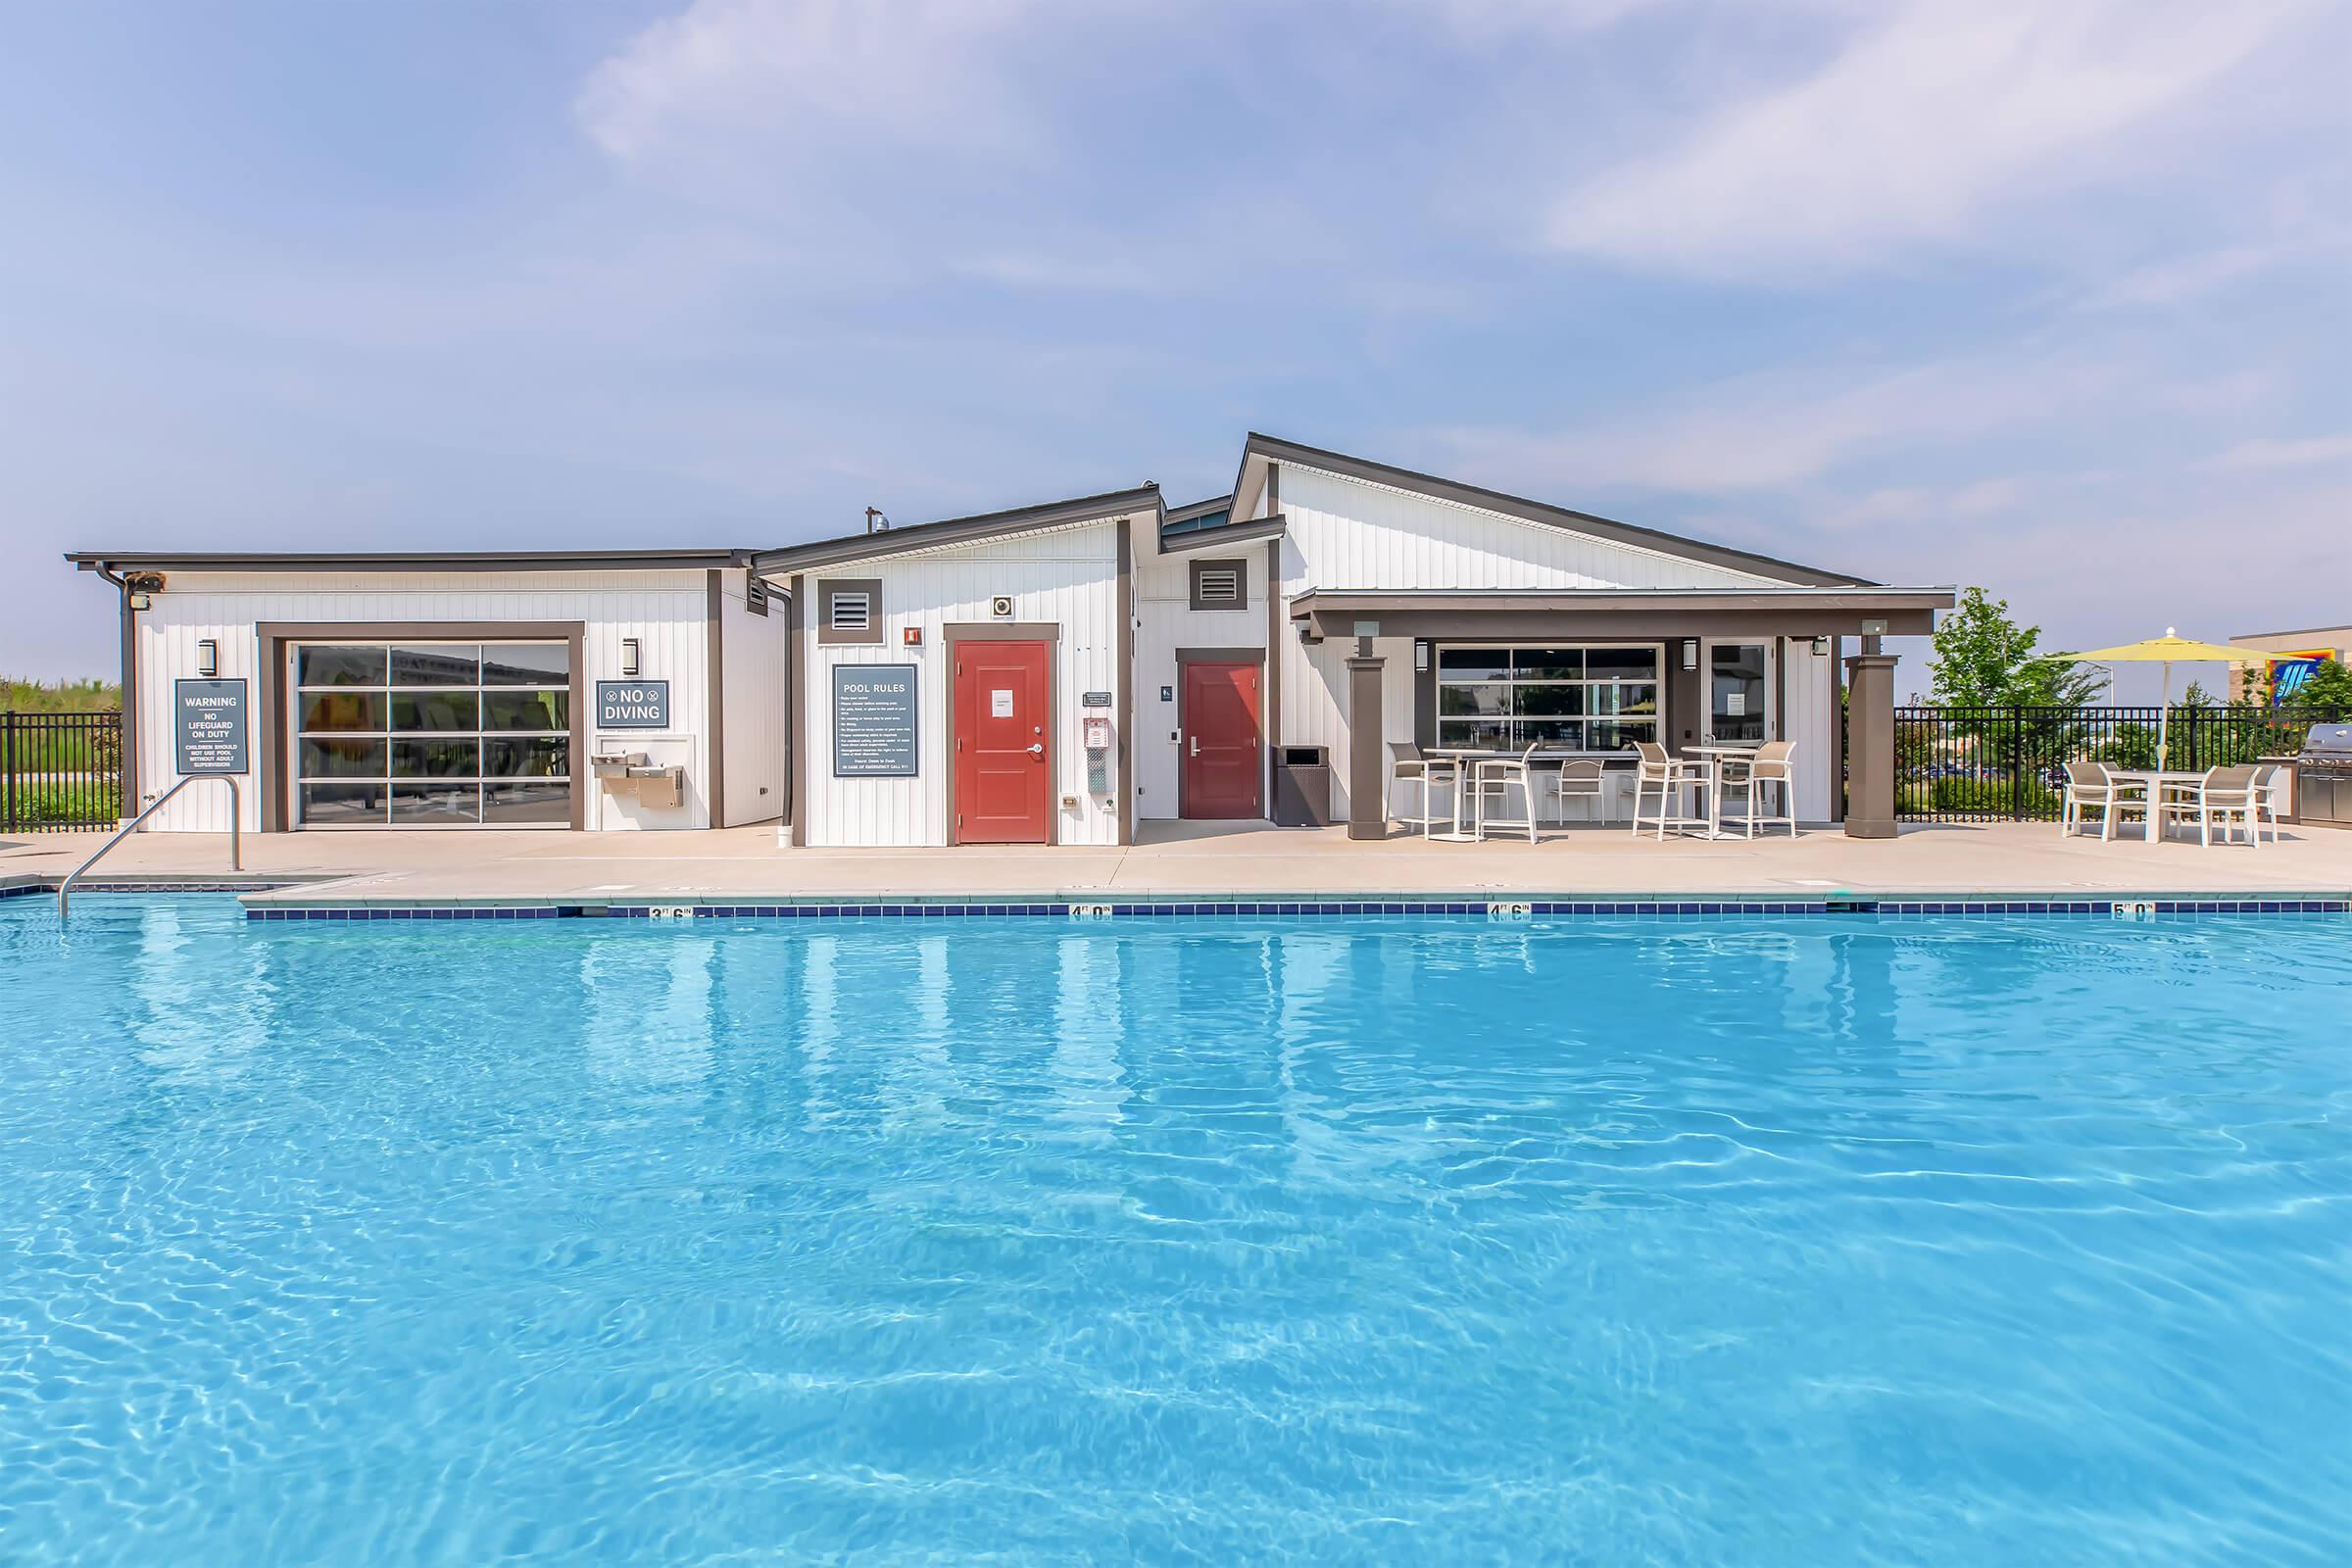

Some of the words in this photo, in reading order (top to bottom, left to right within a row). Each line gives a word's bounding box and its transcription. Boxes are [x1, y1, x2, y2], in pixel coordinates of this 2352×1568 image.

[844, 684, 870, 693] POOL
[873, 683, 906, 692] RULES
[620, 689, 644, 703] NO
[185, 697, 237, 707] WARNING
[605, 706, 660, 719] DIVING
